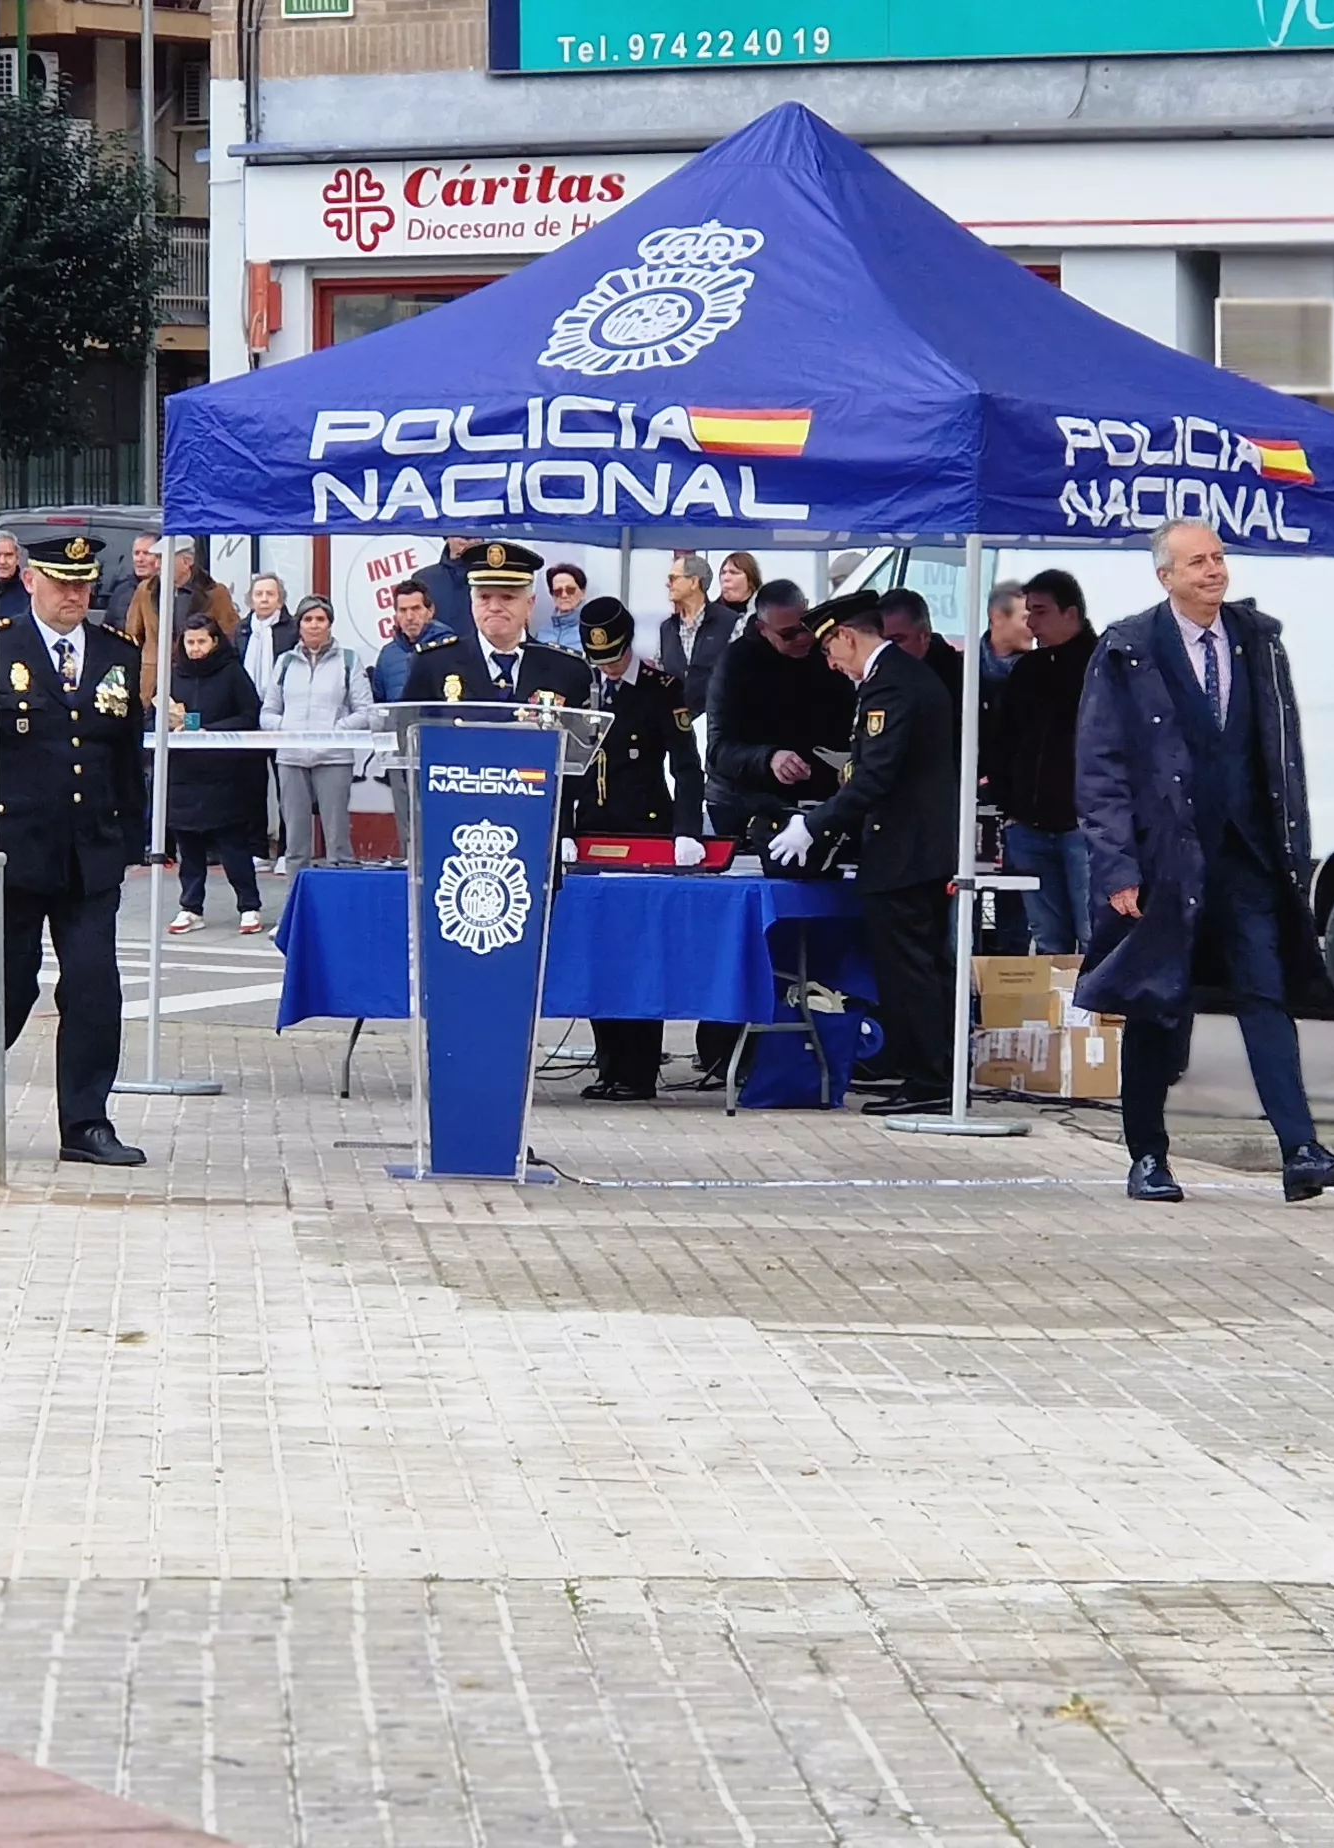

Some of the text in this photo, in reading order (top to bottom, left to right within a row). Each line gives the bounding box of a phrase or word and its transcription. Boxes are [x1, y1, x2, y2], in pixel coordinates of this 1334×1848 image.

[557, 35, 619, 63] Tel.
[403, 164, 626, 209] Cáritas
[407, 216, 525, 241] Diocesana
[534, 214, 562, 238] de
[1056, 416, 1262, 475] POLICIA
[312, 460, 810, 524] NACIONAL
[1059, 476, 1310, 543] NACIONAL
[366, 548, 419, 582] INTE
[429, 765, 522, 781] POLICIA
[429, 780, 545, 796] NACIONAL
